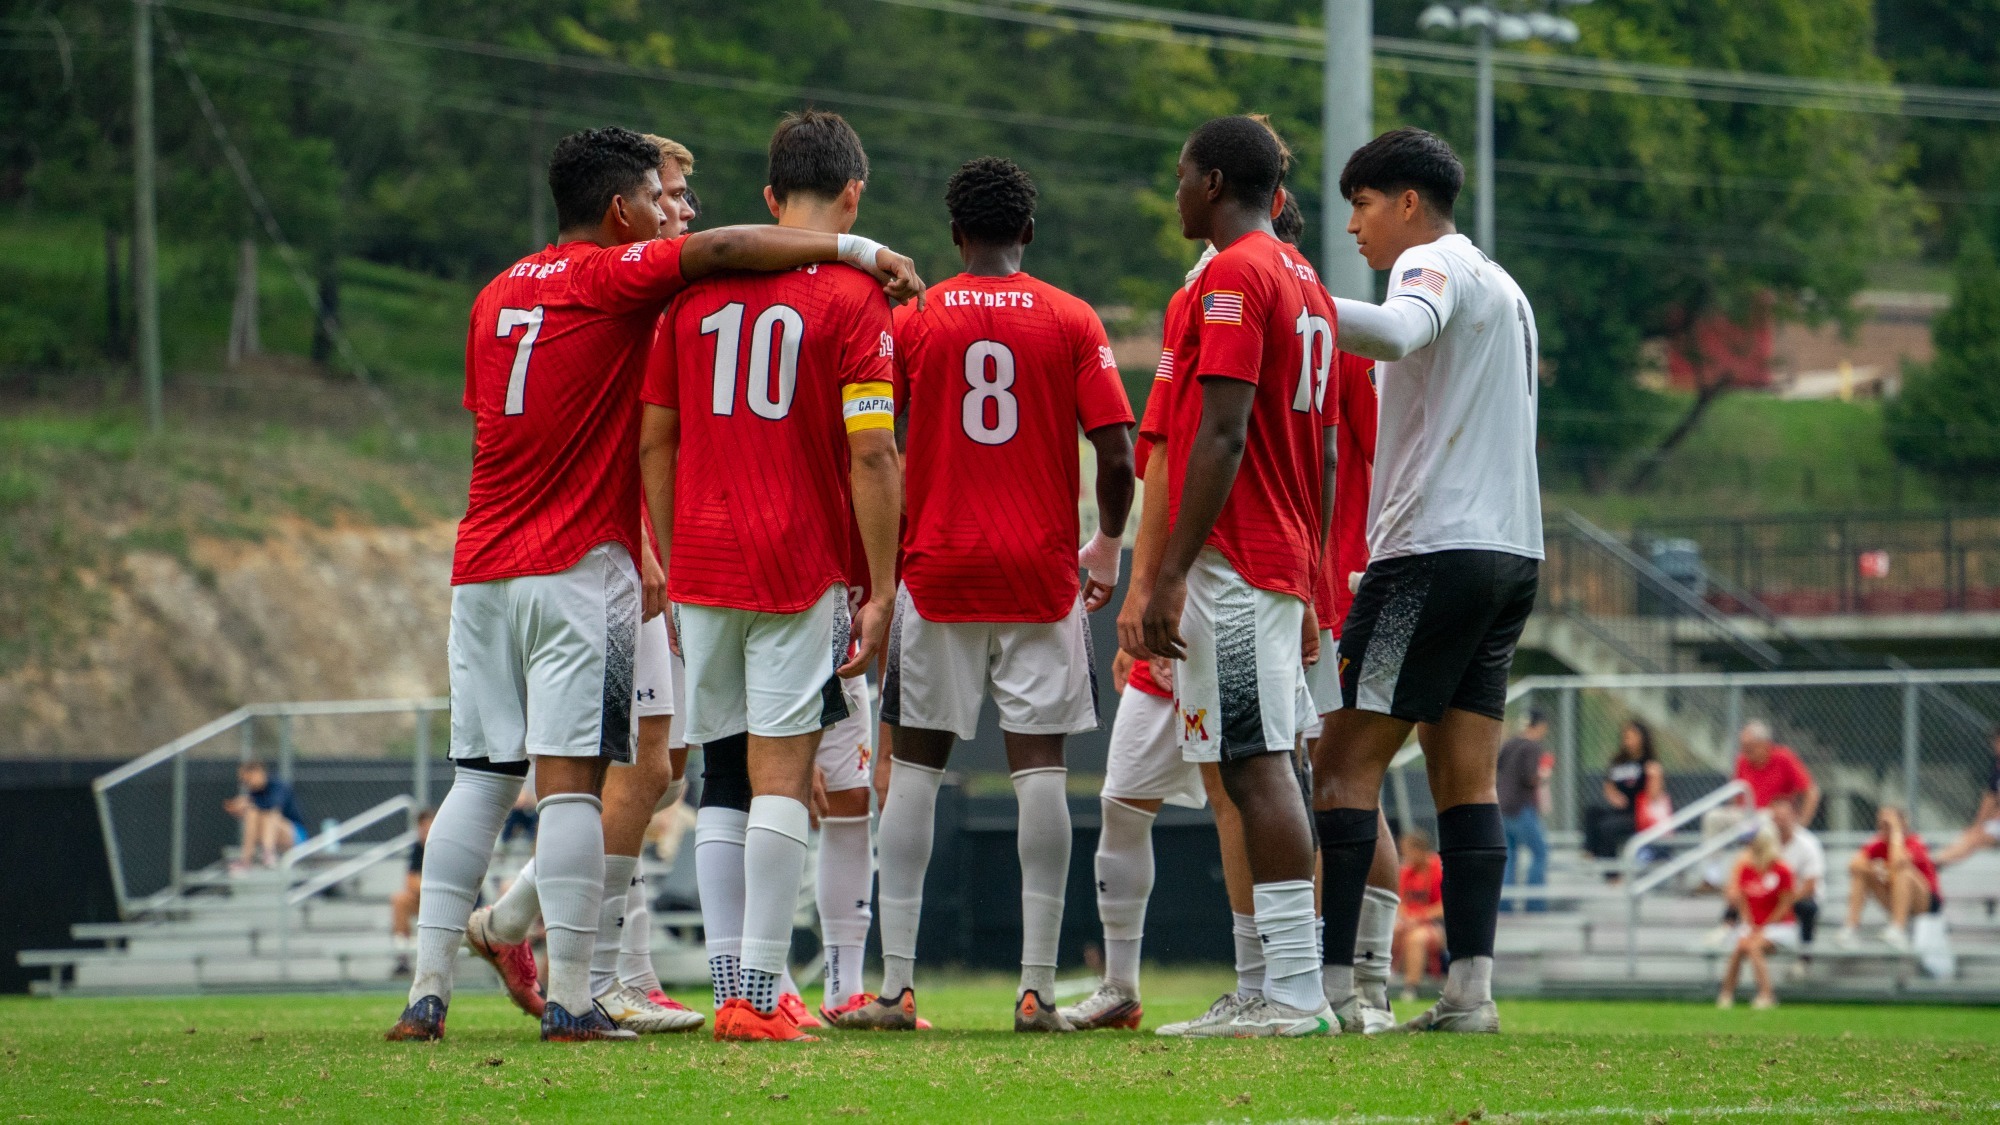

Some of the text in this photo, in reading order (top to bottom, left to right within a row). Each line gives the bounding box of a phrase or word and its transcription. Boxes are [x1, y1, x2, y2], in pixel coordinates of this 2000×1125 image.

[944, 290, 1034, 308] KEYDETS
[496, 304, 544, 416] 7
[700, 302, 804, 420] 10
[962, 338, 1019, 446] 8
